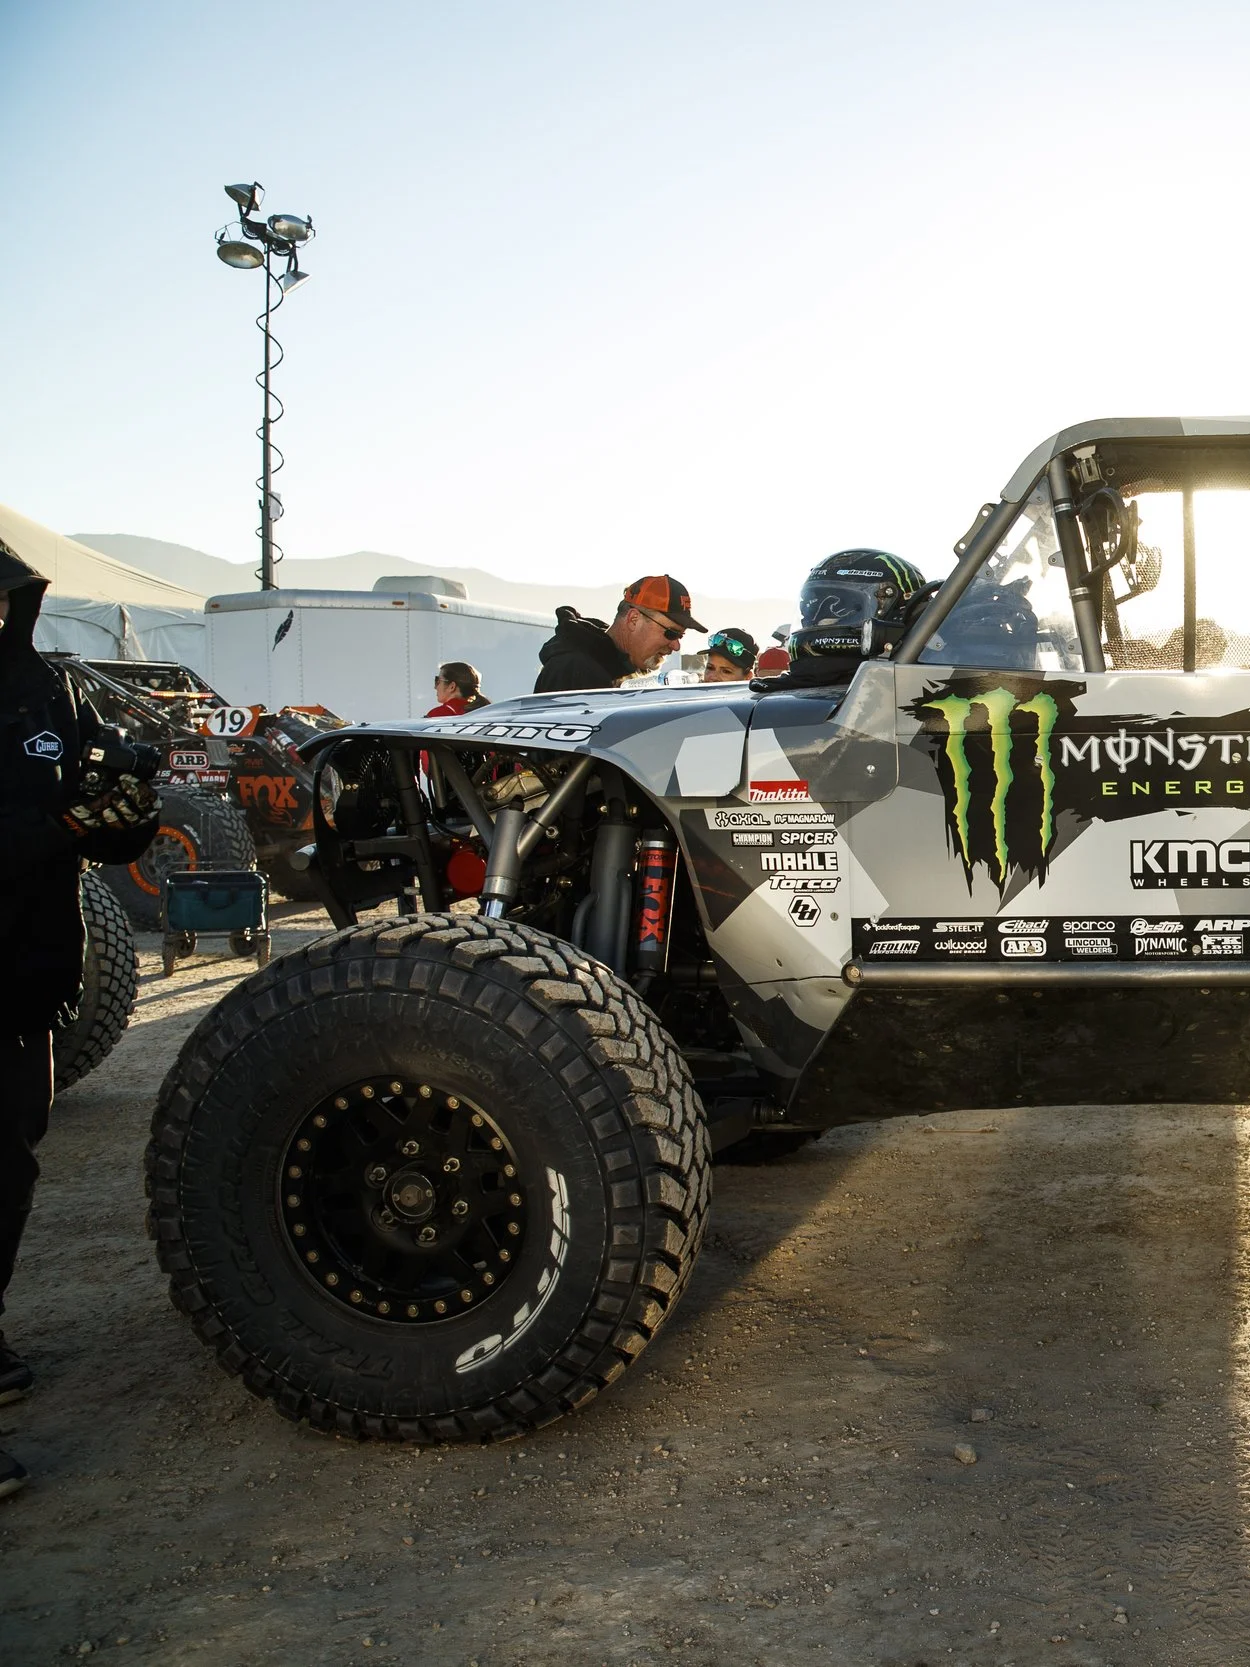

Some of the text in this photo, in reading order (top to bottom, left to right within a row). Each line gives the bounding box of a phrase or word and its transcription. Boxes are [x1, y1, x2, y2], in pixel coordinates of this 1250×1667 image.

[214, 709, 246, 734] 19
[175, 755, 205, 766] ARB
[201, 775, 226, 783] WARN
[237, 775, 298, 820] FOX
[788, 814, 835, 823] MAGNAFLOW
[732, 833, 773, 843] CHAMPION
[780, 832, 835, 844] SPICER
[760, 852, 838, 871] MAHLE
[1133, 878, 1250, 886] WHEELS
[640, 876, 668, 943] FOX
[945, 923, 984, 933] STEEL-IT
[998, 920, 1050, 934] Eibach
[1063, 921, 1115, 934] sparco
[871, 941, 920, 951] REDLINE
[935, 938, 987, 950] wilwood
[1006, 941, 1043, 953] ARB
[1135, 938, 1187, 955] DYNAMIC
